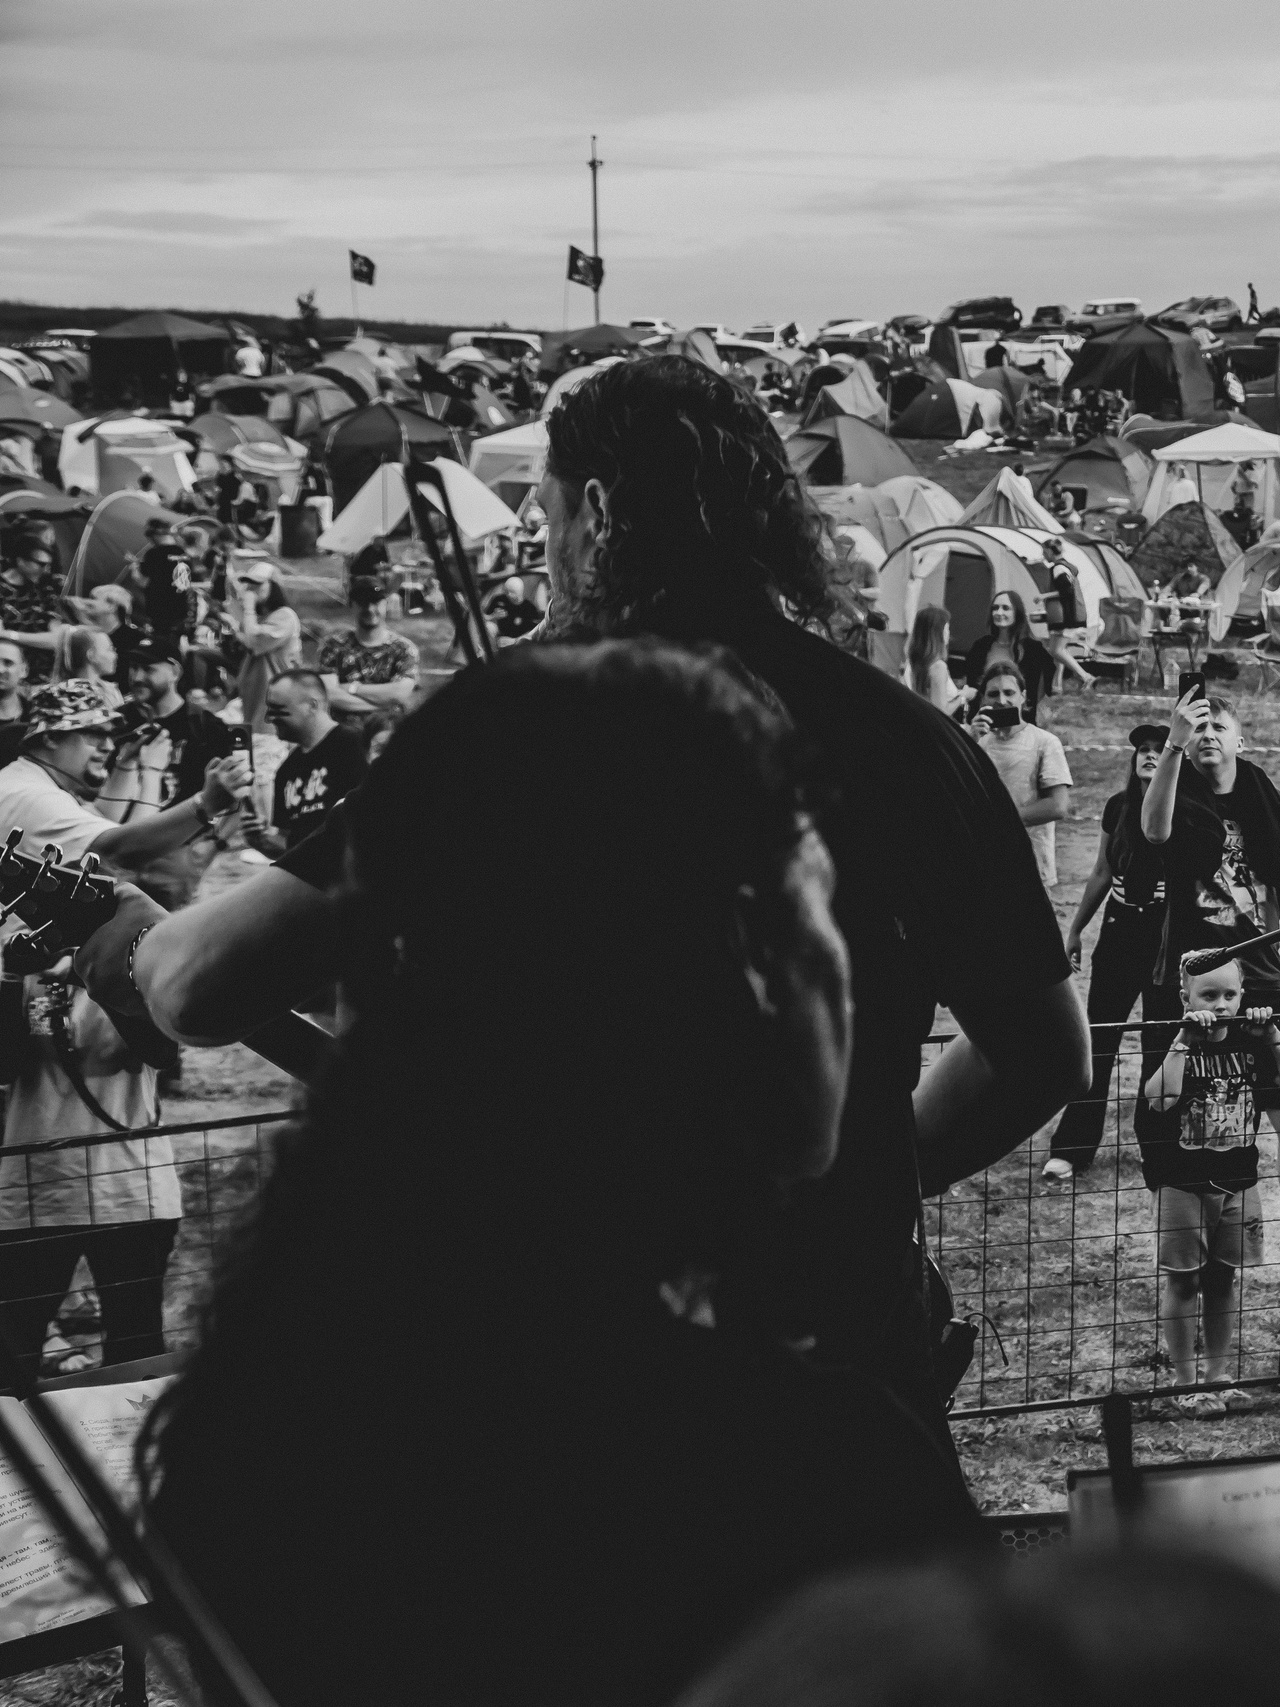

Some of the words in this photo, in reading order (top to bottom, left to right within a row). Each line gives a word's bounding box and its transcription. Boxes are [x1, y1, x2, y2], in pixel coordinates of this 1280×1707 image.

[6, 1554, 31, 1568] небес
[0, 1575, 23, 1588] елест
[24, 1563, 52, 1577] травы,
[1, 1572, 51, 1598] дремлющий
